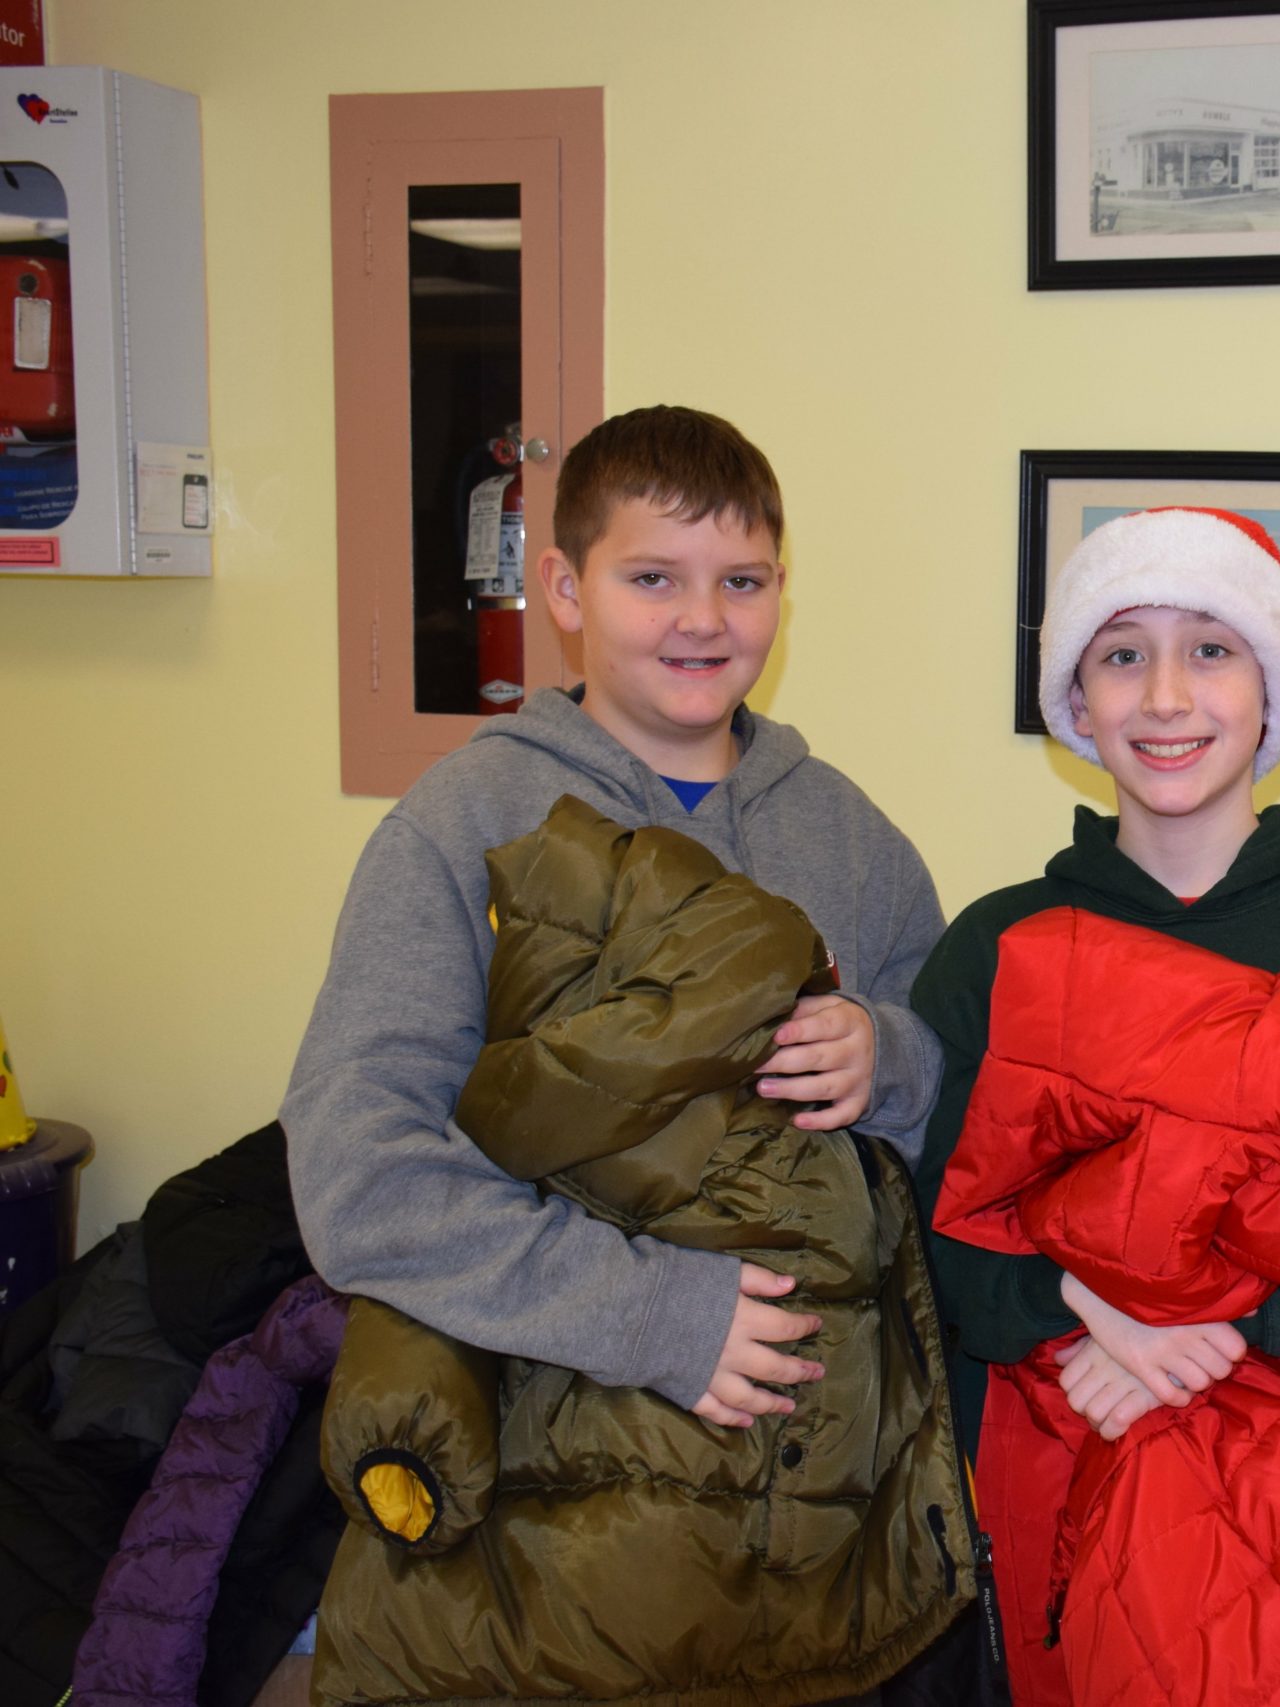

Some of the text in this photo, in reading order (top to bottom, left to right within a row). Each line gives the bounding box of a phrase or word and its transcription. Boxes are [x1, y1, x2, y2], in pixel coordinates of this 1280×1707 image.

[0, 22, 26, 47] tor
[984, 1587, 993, 1614] POLO
[987, 1614, 998, 1647] JEANS
